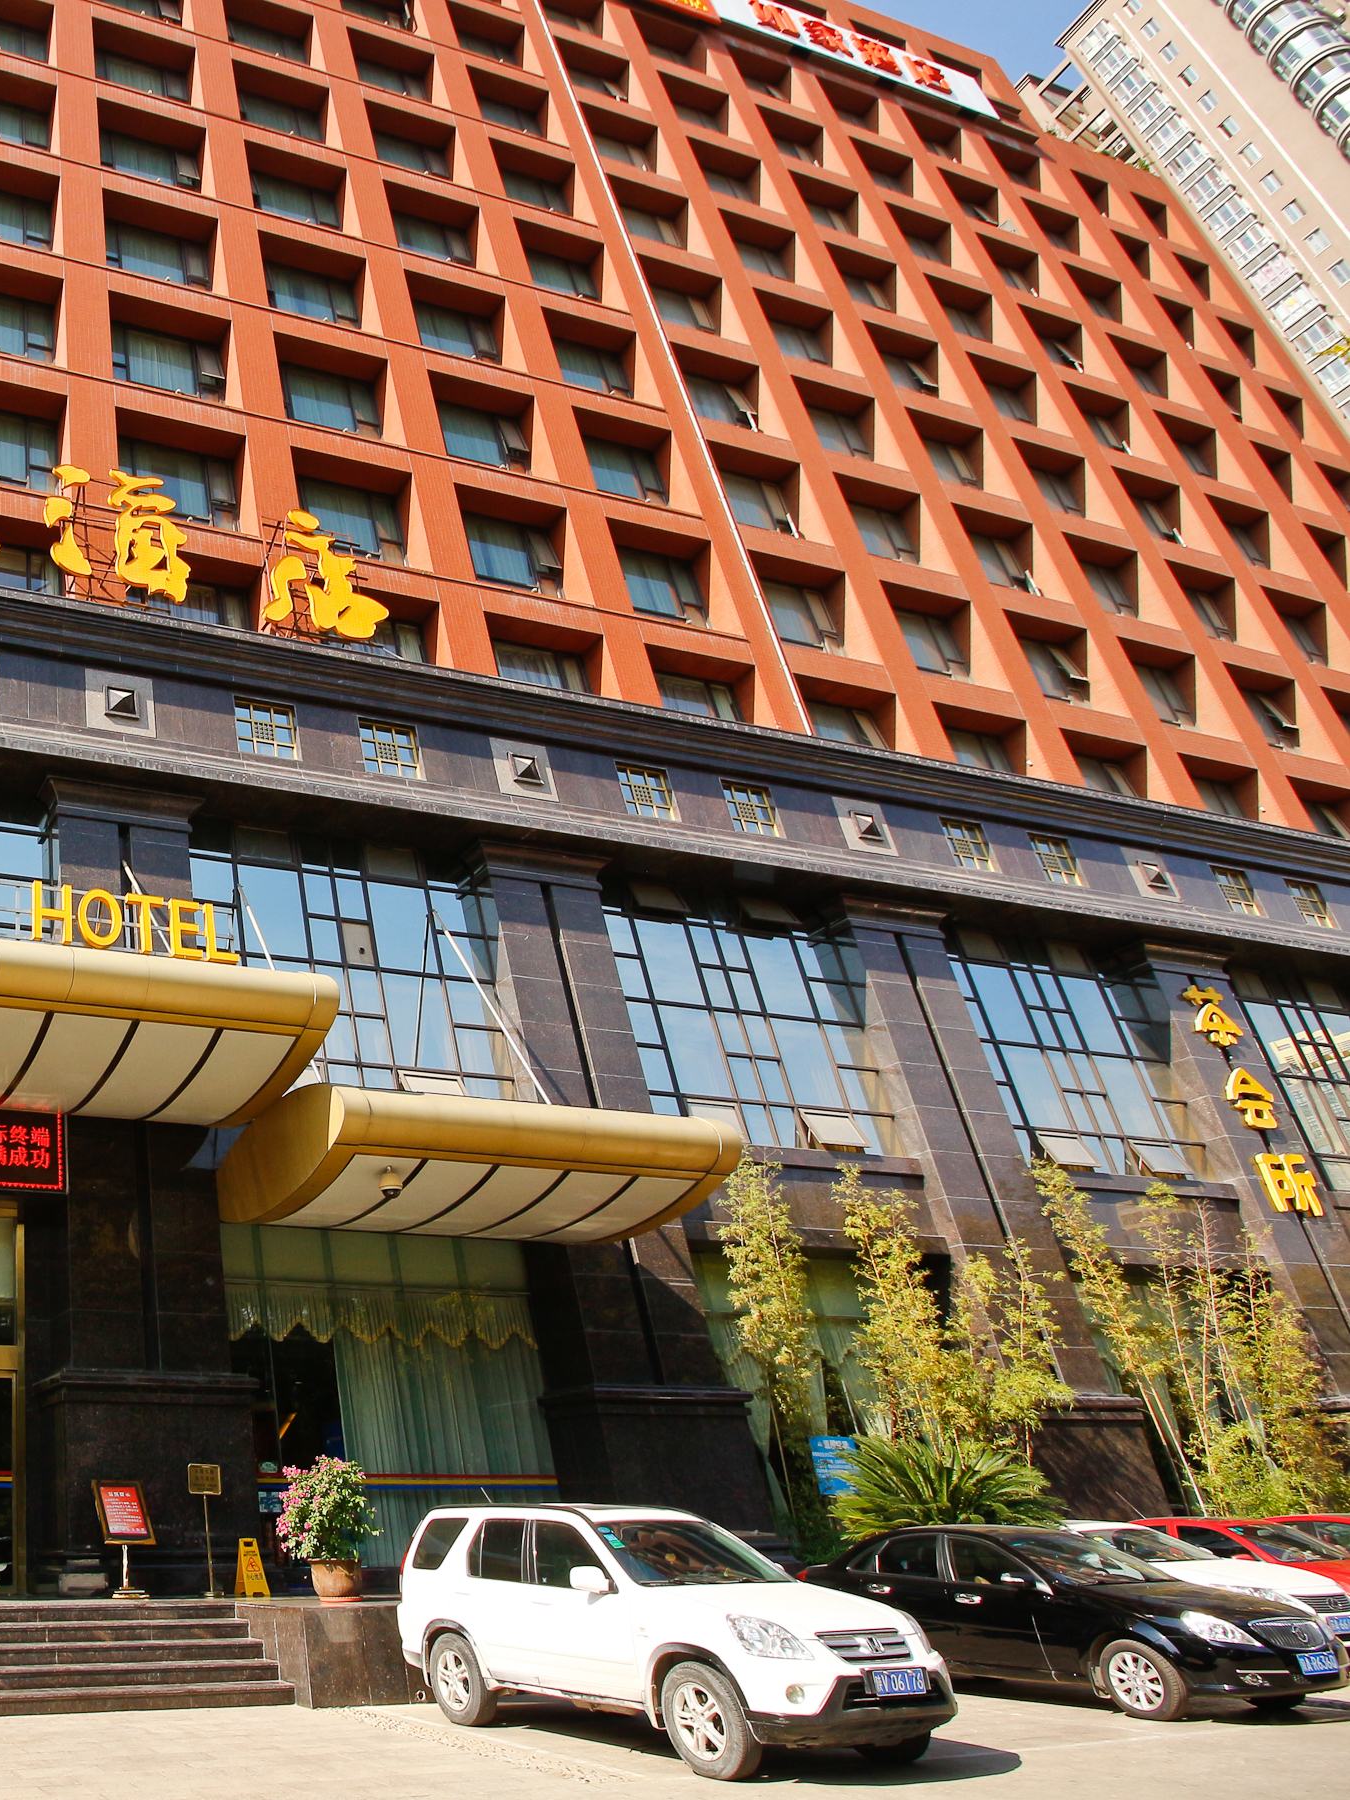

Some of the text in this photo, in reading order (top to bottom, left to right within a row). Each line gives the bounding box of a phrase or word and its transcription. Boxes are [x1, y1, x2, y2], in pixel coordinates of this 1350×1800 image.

[30, 880, 240, 965] HOTEL
[1182, 985, 1325, 1218] 茶会所
